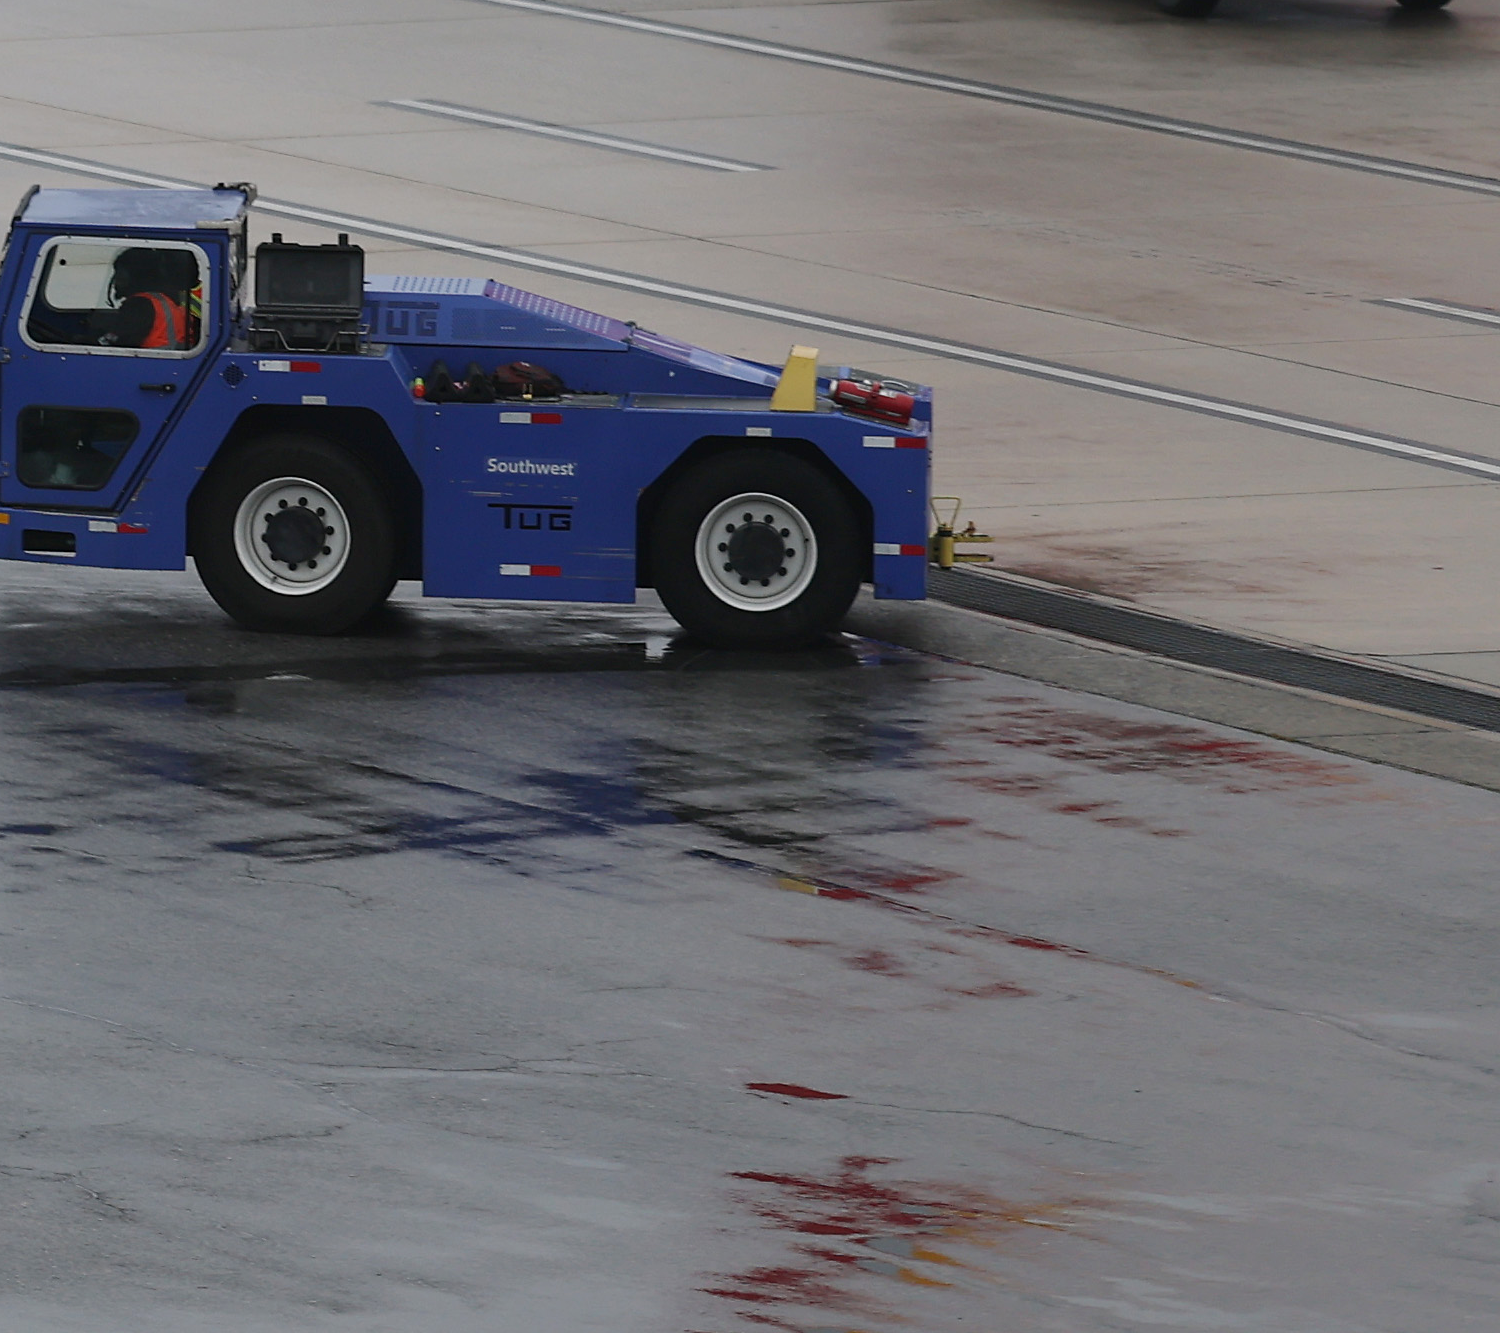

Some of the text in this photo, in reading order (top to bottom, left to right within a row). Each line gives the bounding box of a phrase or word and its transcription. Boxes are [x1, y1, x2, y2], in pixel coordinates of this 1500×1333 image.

[362, 299, 441, 337] TUG
[487, 457, 575, 477] Southwest
[487, 502, 573, 531] TUG
